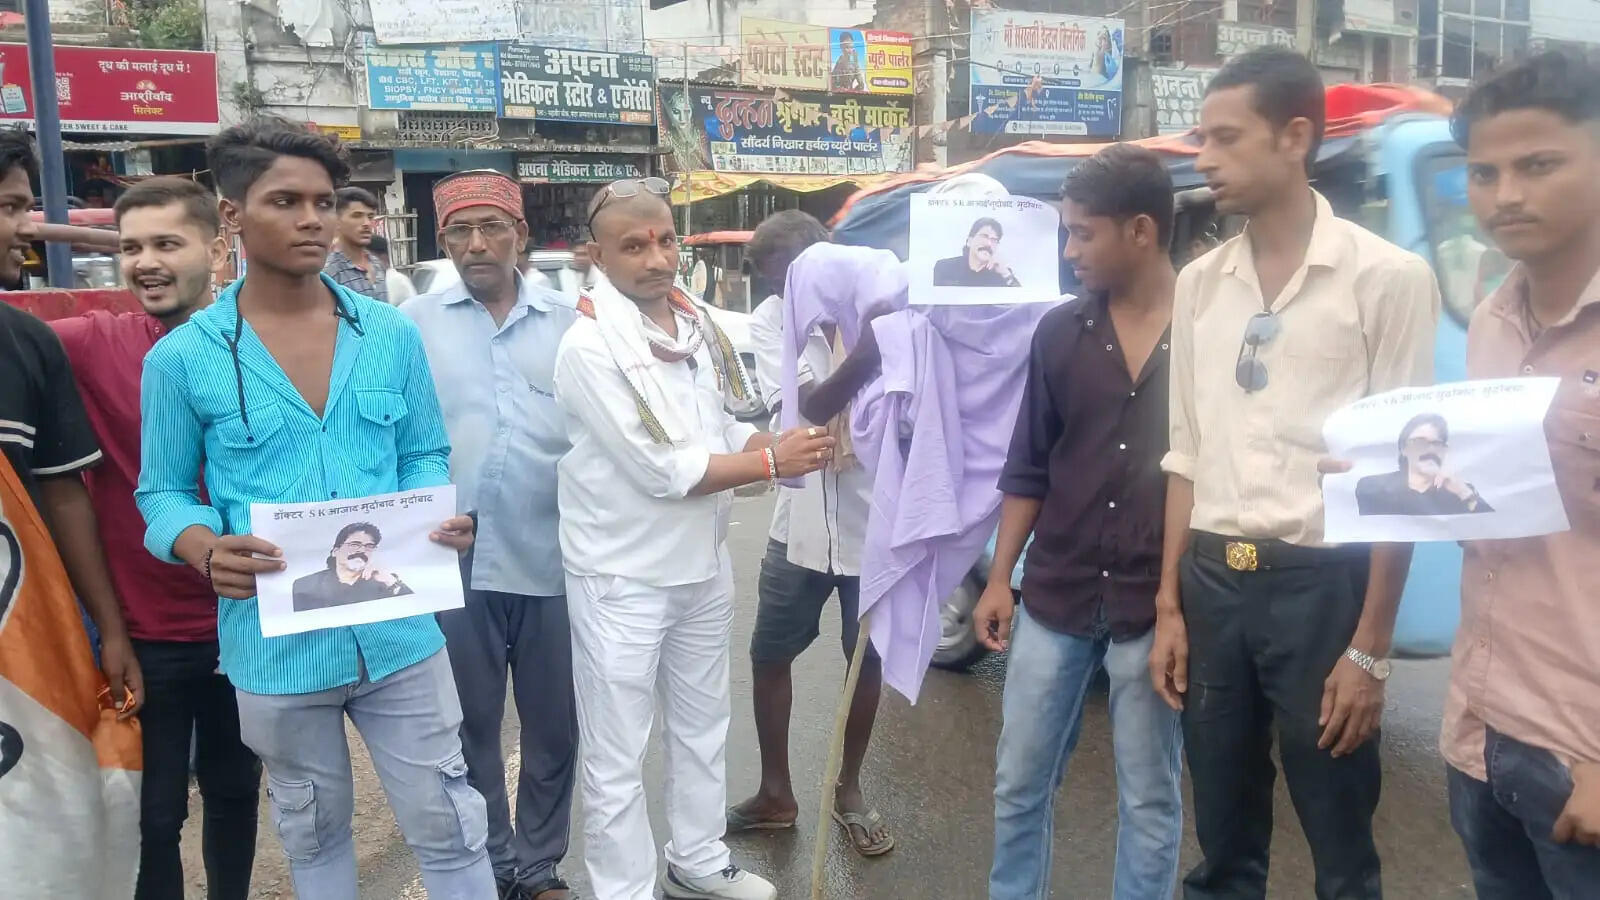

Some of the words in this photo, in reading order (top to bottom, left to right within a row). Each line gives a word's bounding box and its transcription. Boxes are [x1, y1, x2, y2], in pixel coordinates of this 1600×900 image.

[98, 60, 113, 73] दूध
[115, 59, 129, 71] की
[132, 59, 158, 72] मलाई
[160, 62, 174, 75] दूध
[544, 49, 620, 79] अपना
[120, 91, 174, 105] आशीर्वाद
[501, 71, 559, 106] मेडिकल
[563, 75, 594, 108] स्टोर
[597, 88, 608, 104] &
[609, 78, 652, 111] एजेंसी
[133, 104, 164, 116] सिलेक्ट
[772, 136, 804, 151] निखार
[518, 162, 549, 177] अपना
[552, 160, 590, 177] मेडिकल
[593, 160, 613, 177] स्टोर
[273, 509, 304, 520] डॉक्टर
[309, 508, 316, 518] S
[318, 507, 326, 517] K
[328, 505, 358, 516] आजाद
